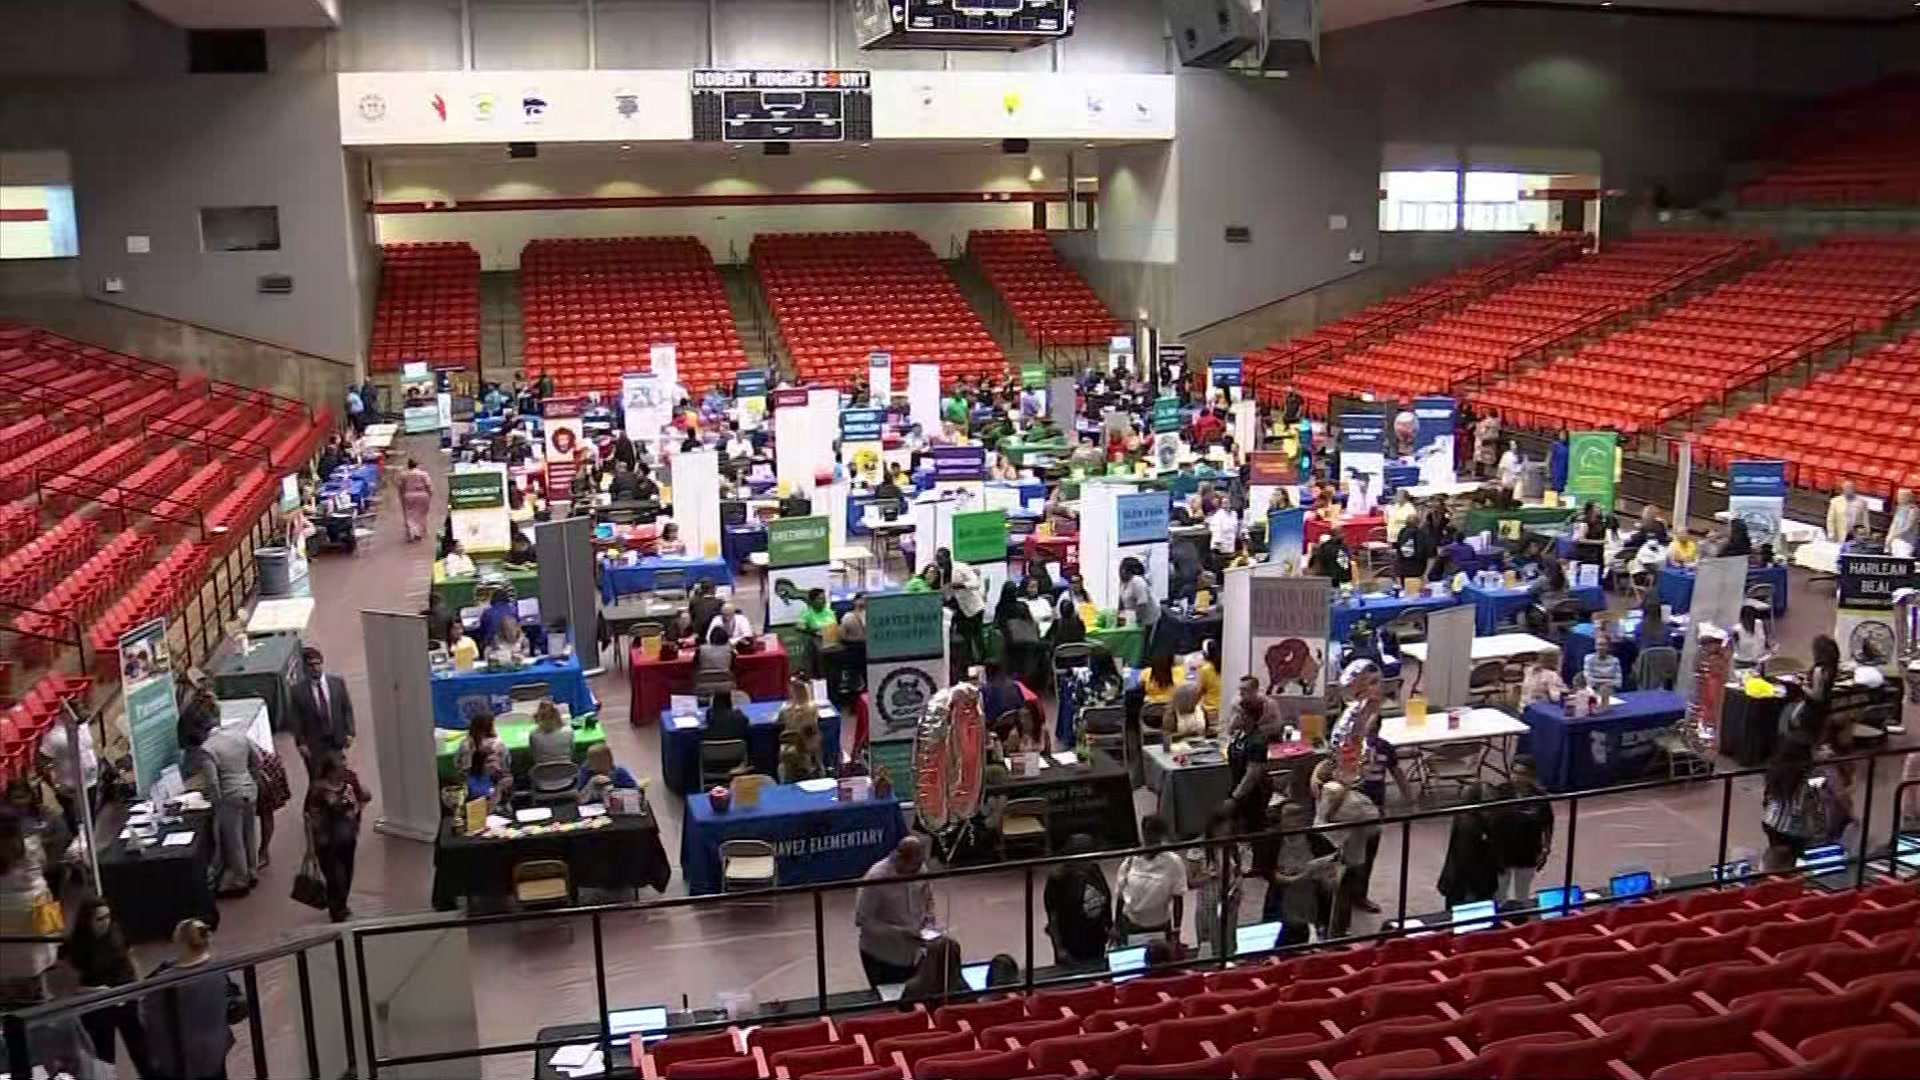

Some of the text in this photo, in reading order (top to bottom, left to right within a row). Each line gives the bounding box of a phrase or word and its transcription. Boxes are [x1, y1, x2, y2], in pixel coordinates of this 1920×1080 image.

[695, 72, 750, 87] ROBERT
[755, 72, 814, 87] HUGHES
[1849, 562, 1907, 576] HARLEAN
[1861, 580, 1890, 594] BEAL
[810, 828, 885, 854] ELEMENTARY
